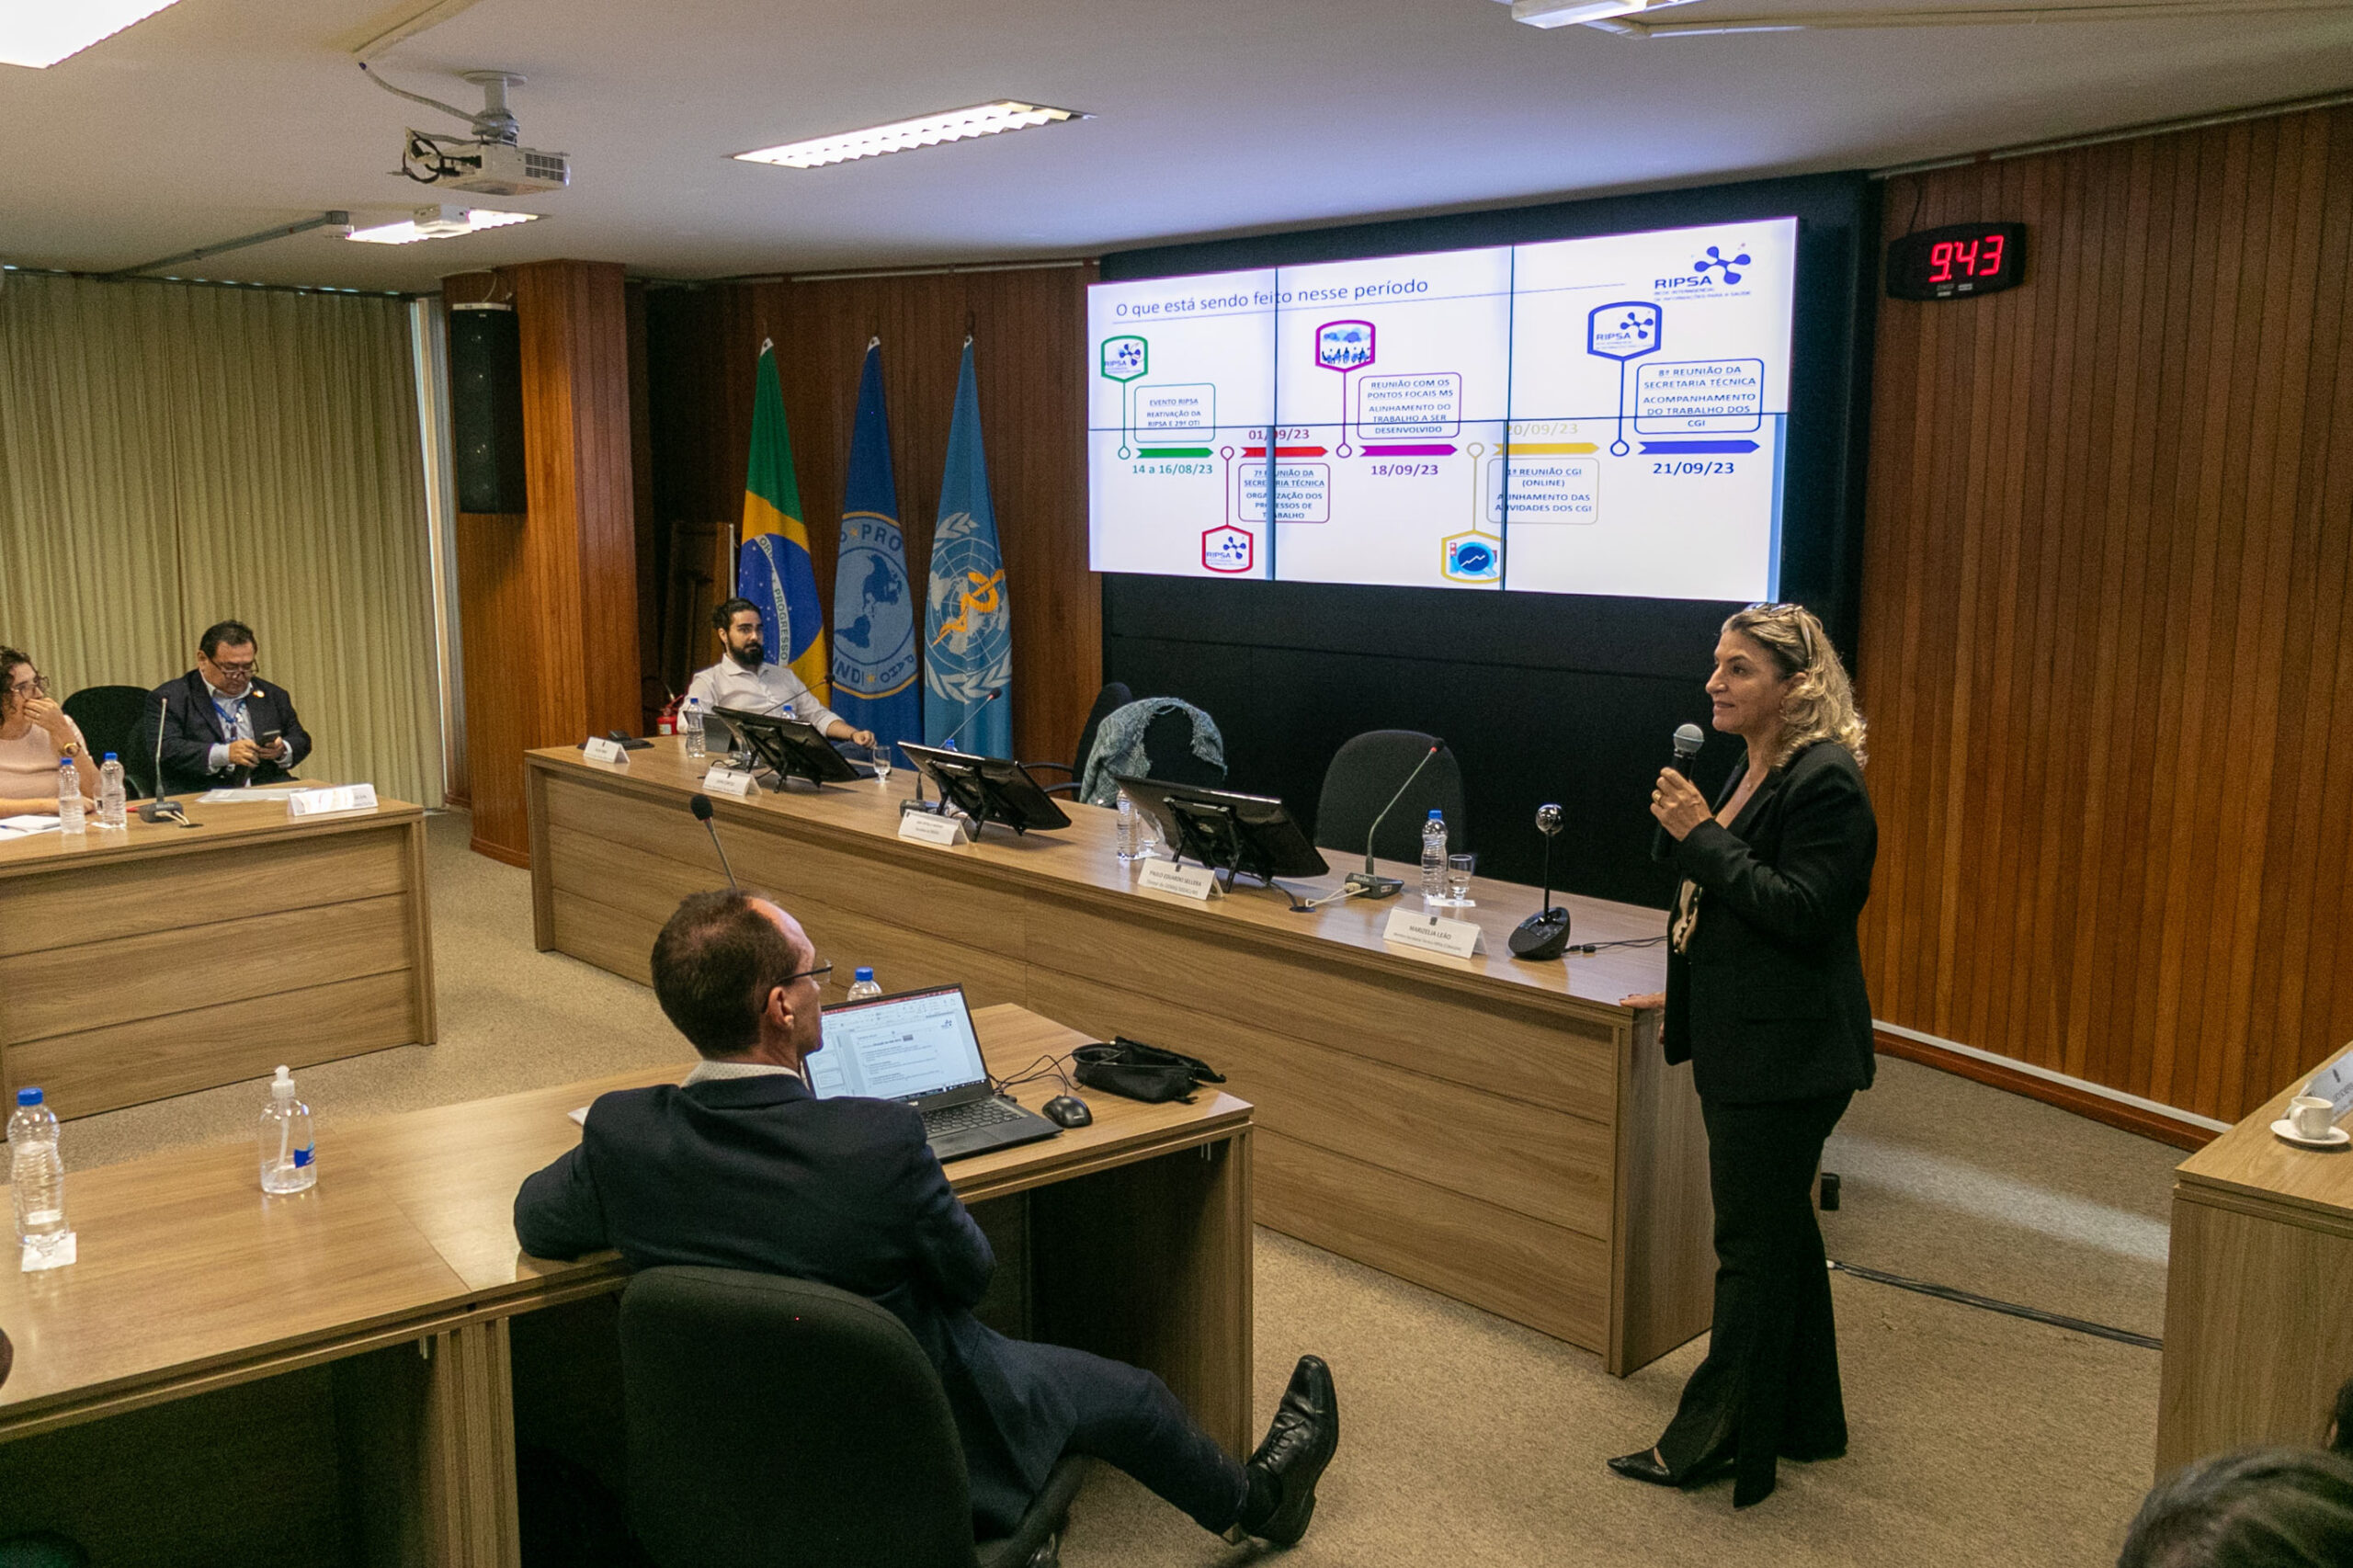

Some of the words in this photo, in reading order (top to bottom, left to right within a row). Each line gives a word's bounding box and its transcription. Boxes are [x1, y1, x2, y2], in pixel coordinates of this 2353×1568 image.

[1654, 276, 1712, 289] RIPSA
[1116, 303, 1128, 316] O
[1132, 303, 1160, 317] que
[1165, 297, 1195, 312] está
[1200, 294, 1248, 310] sendo
[1254, 291, 1292, 305] feito
[1298, 287, 1348, 301] nesse
[1355, 278, 1428, 300] período
[1596, 332, 1631, 341] RIPSA
[1673, 366, 1722, 376] REUNIÃO
[1725, 366, 1742, 374] DA
[1370, 380, 1411, 388] REUNIÃO
[1644, 380, 1706, 389] SECRETARIA
[1711, 378, 1756, 386] TÉCNICA
[1643, 393, 1756, 403] ACOMPANHAMENTO
[1369, 403, 1434, 412] ALINHAMENTO
[1667, 406, 1723, 415] TRABALHO
[1727, 405, 1750, 414] DOS
[1147, 410, 1189, 418] REATIVAÇÃO
[1373, 415, 1419, 423] TRABALHO
[1688, 419, 1706, 427] CGI
[1248, 428, 1310, 441] 019/23
[1375, 426, 1442, 434] DESENVOLVIDO
[1507, 423, 1578, 437] 20/09/23
[1132, 464, 1145, 474] 14
[1159, 463, 1213, 476] 16/08/23
[1265, 469, 1301, 477] UNIÃO
[1371, 463, 1438, 477] 18/09/23
[1519, 467, 1563, 475] REUNIÃO
[1653, 461, 1734, 476] 21/09/23
[1522, 479, 1565, 487] (ONLINE)
[1246, 492, 1303, 500] ORGAZAÇÃO
[1495, 504, 1550, 512] AVIDADES
[861, 524, 902, 551] PRO
[774, 588, 789, 661] PROGRESSO
